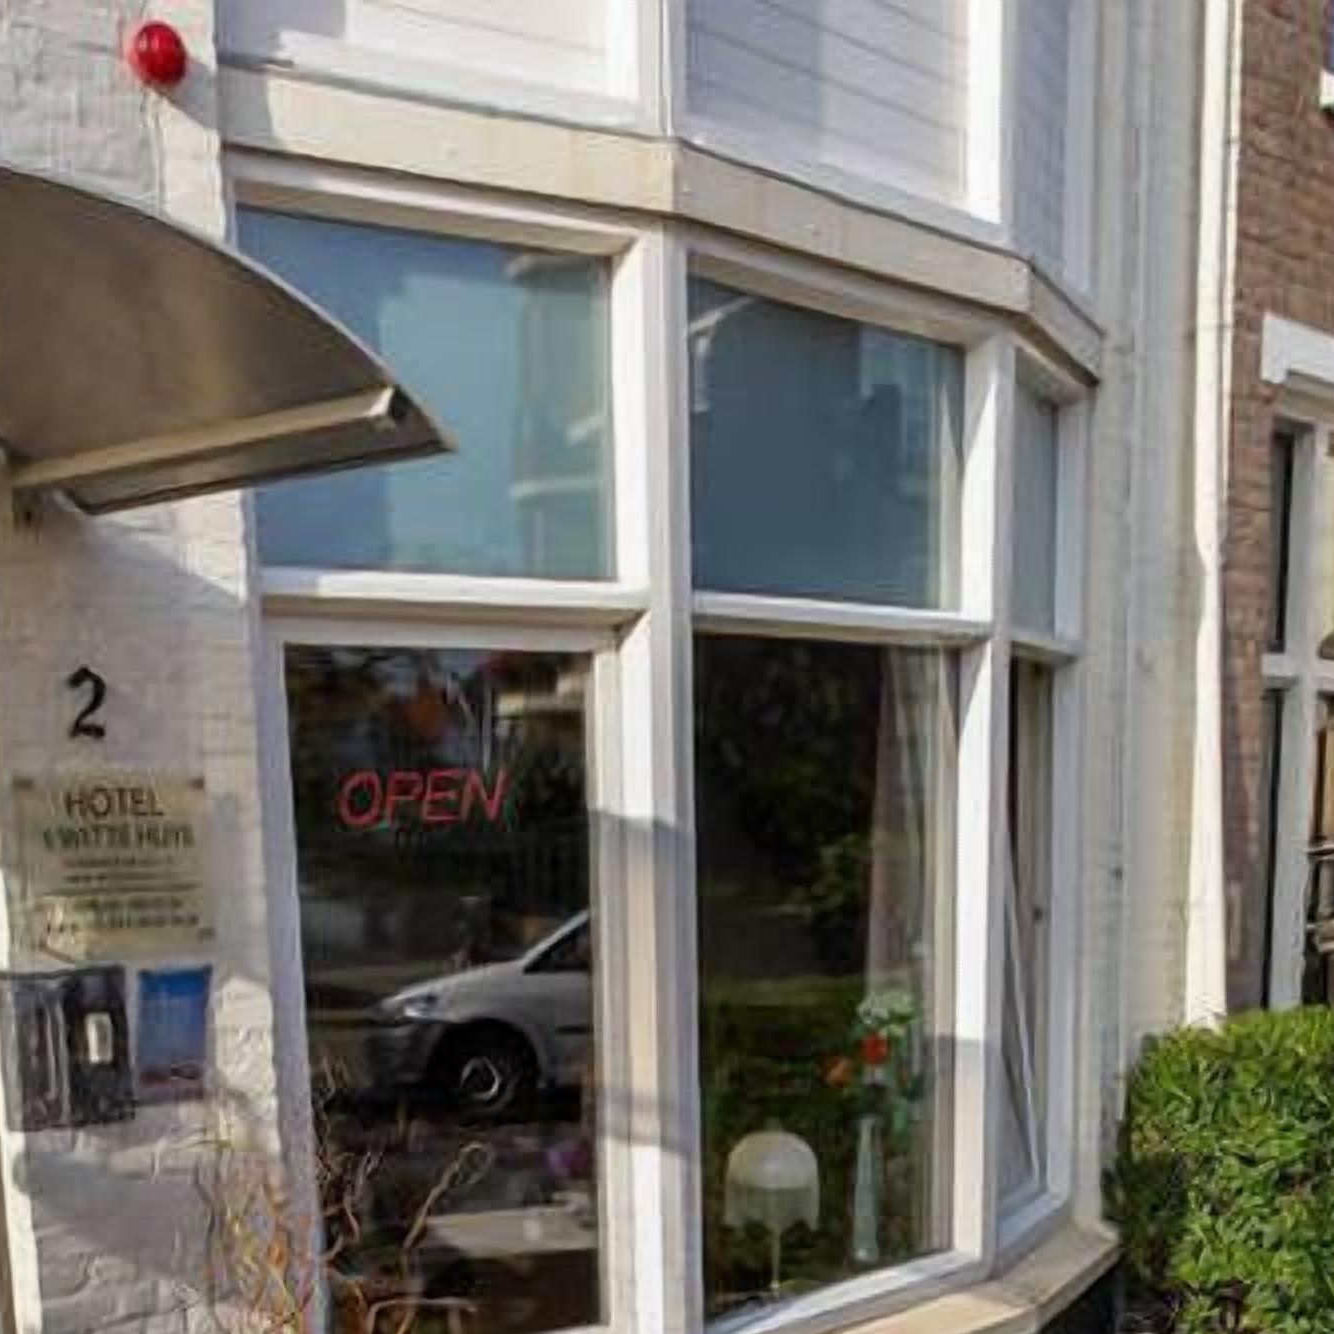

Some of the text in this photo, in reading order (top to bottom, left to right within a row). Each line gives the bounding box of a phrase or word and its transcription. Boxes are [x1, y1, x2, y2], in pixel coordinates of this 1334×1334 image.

[66, 666, 107, 739] 2
[64, 785, 164, 817] HOTEL
[336, 769, 509, 831] OPEN
